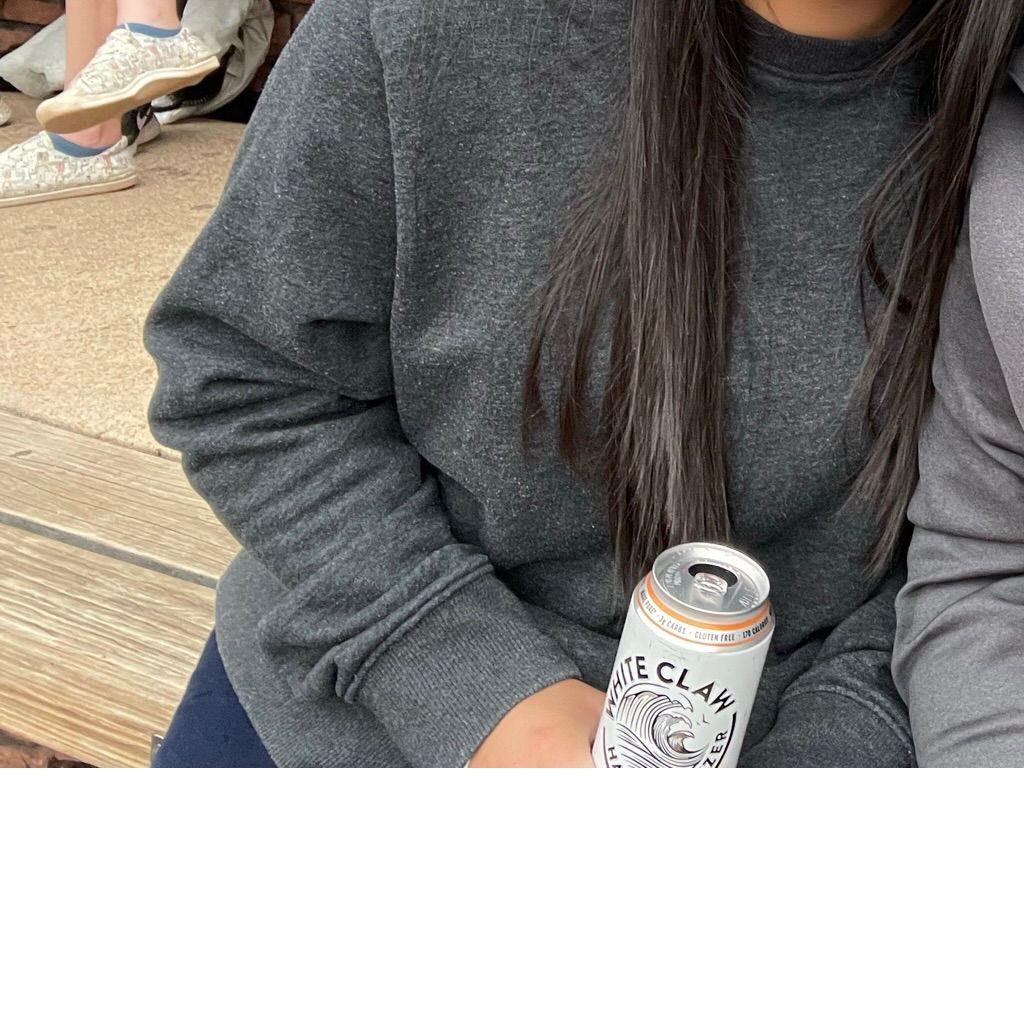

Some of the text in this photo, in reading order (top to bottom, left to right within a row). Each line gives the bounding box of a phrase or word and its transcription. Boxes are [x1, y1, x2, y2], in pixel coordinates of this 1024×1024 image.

[666, 620, 687, 635] CARBS
[694, 631, 720, 642] GLUTEN
[720, 632, 736, 642] FREE
[606, 656, 736, 718] WHITE CLAW
